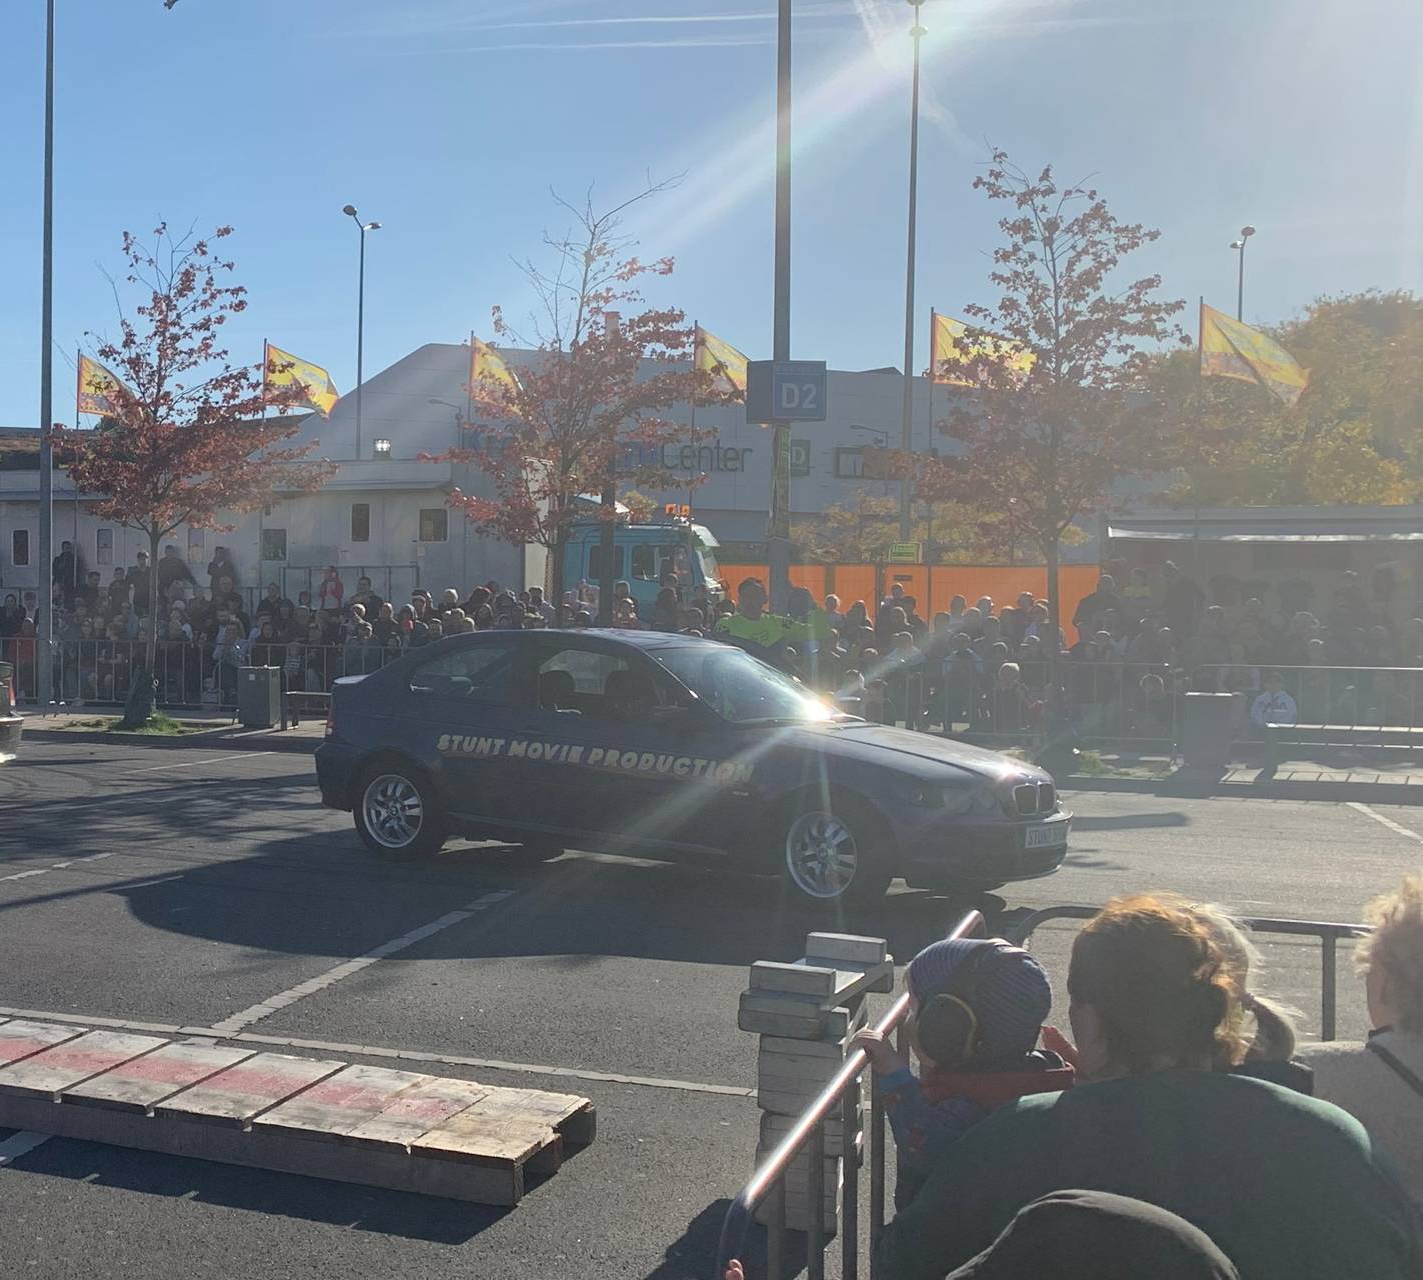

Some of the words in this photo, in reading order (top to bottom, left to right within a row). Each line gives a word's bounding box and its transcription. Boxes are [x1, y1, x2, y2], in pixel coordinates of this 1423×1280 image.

[782, 383, 817, 409] D2
[661, 438, 753, 472] Center
[437, 734, 505, 755] STUNT
[508, 740, 584, 763] MOVIE
[587, 748, 754, 783] PRODUCTION
